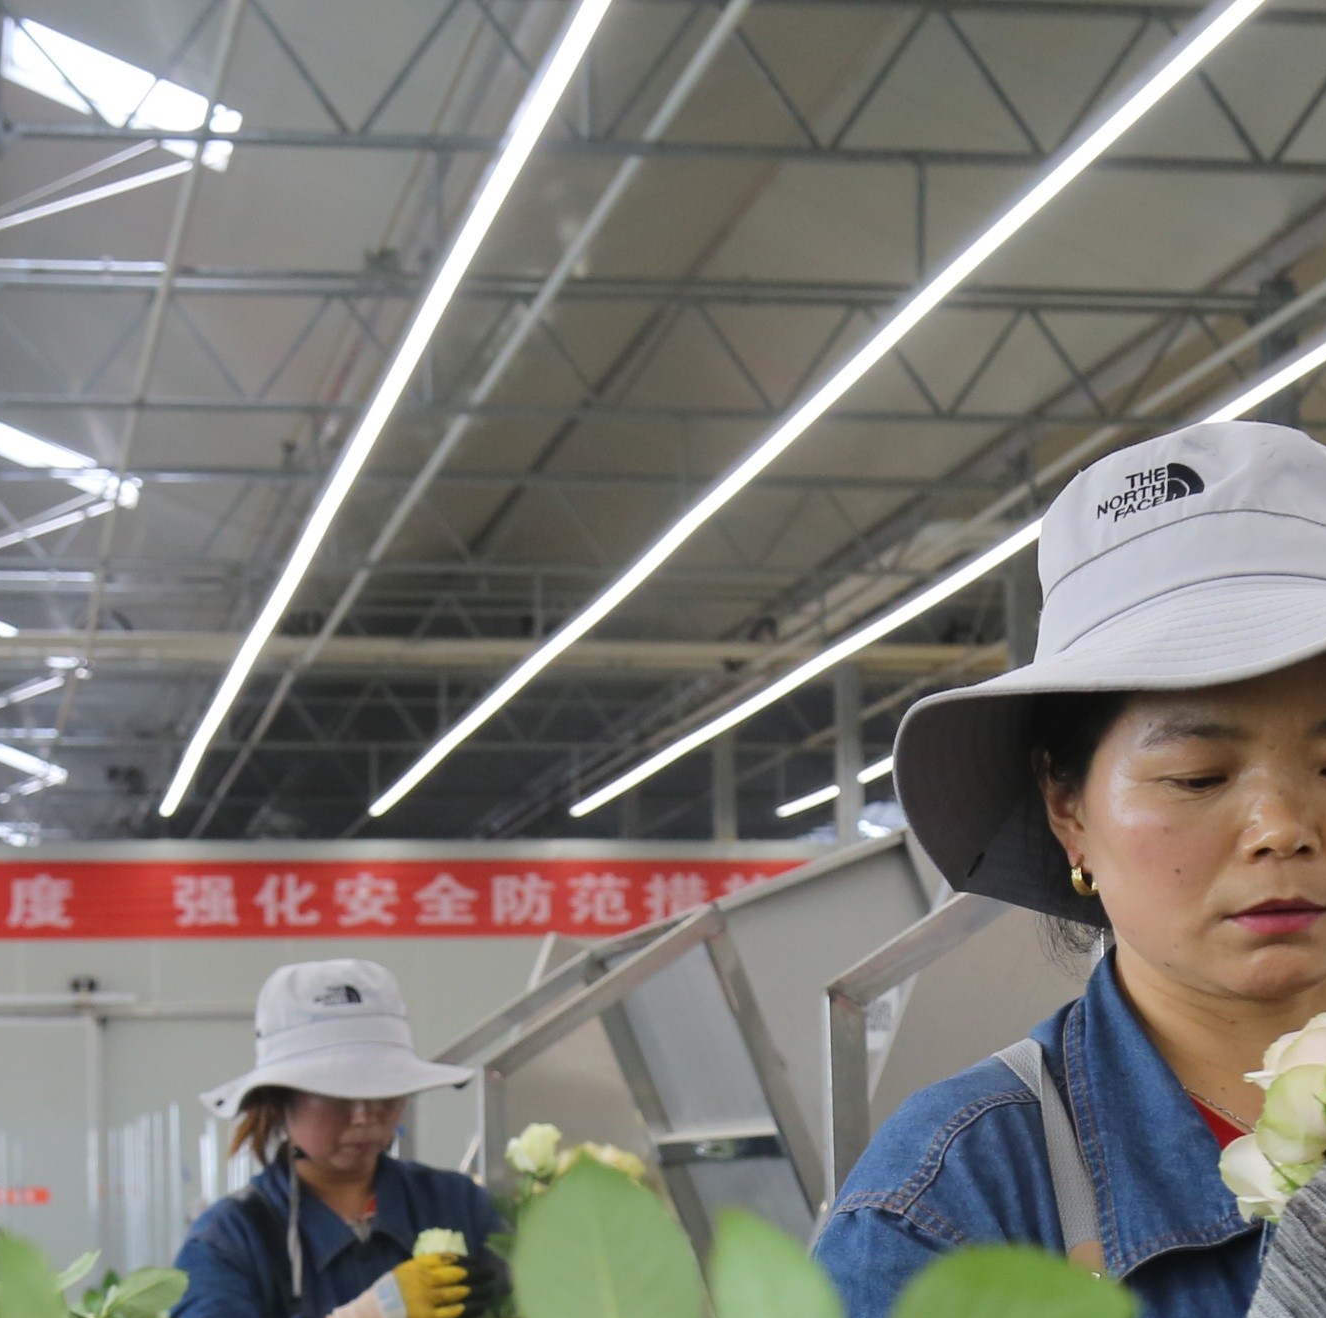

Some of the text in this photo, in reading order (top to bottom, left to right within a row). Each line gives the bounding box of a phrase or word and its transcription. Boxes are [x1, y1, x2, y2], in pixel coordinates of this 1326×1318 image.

[1125, 466, 1167, 489] THE
[1097, 481, 1166, 520] NORTH
[1113, 495, 1165, 522] FACE
